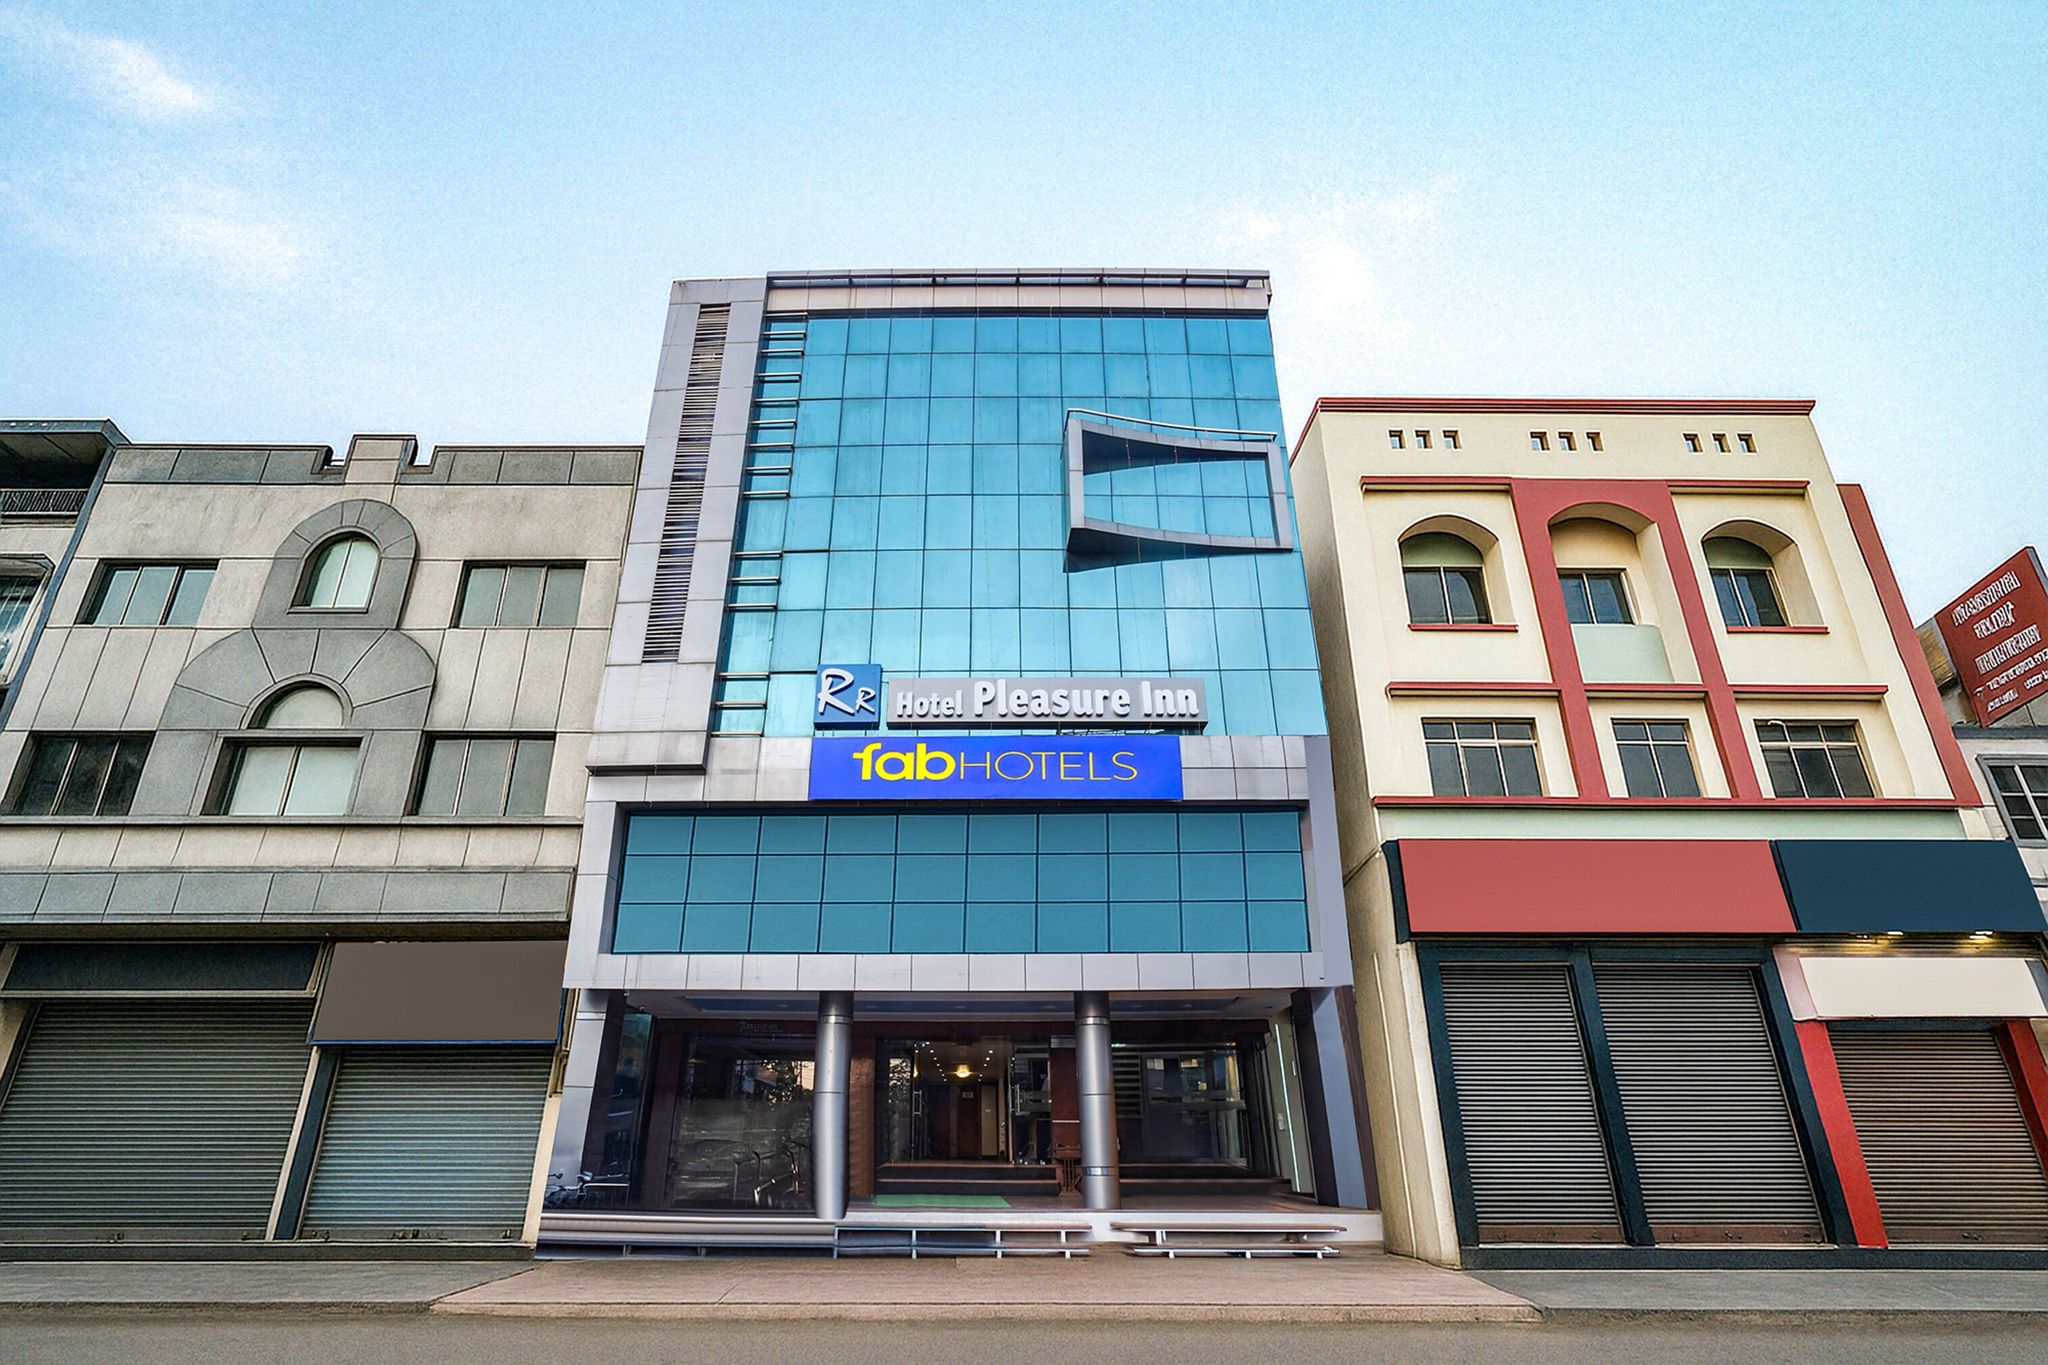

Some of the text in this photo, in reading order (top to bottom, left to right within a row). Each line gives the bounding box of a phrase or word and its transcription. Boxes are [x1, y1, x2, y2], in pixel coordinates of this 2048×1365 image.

[897, 679, 1199, 716] Hotel Pleasure Inn
